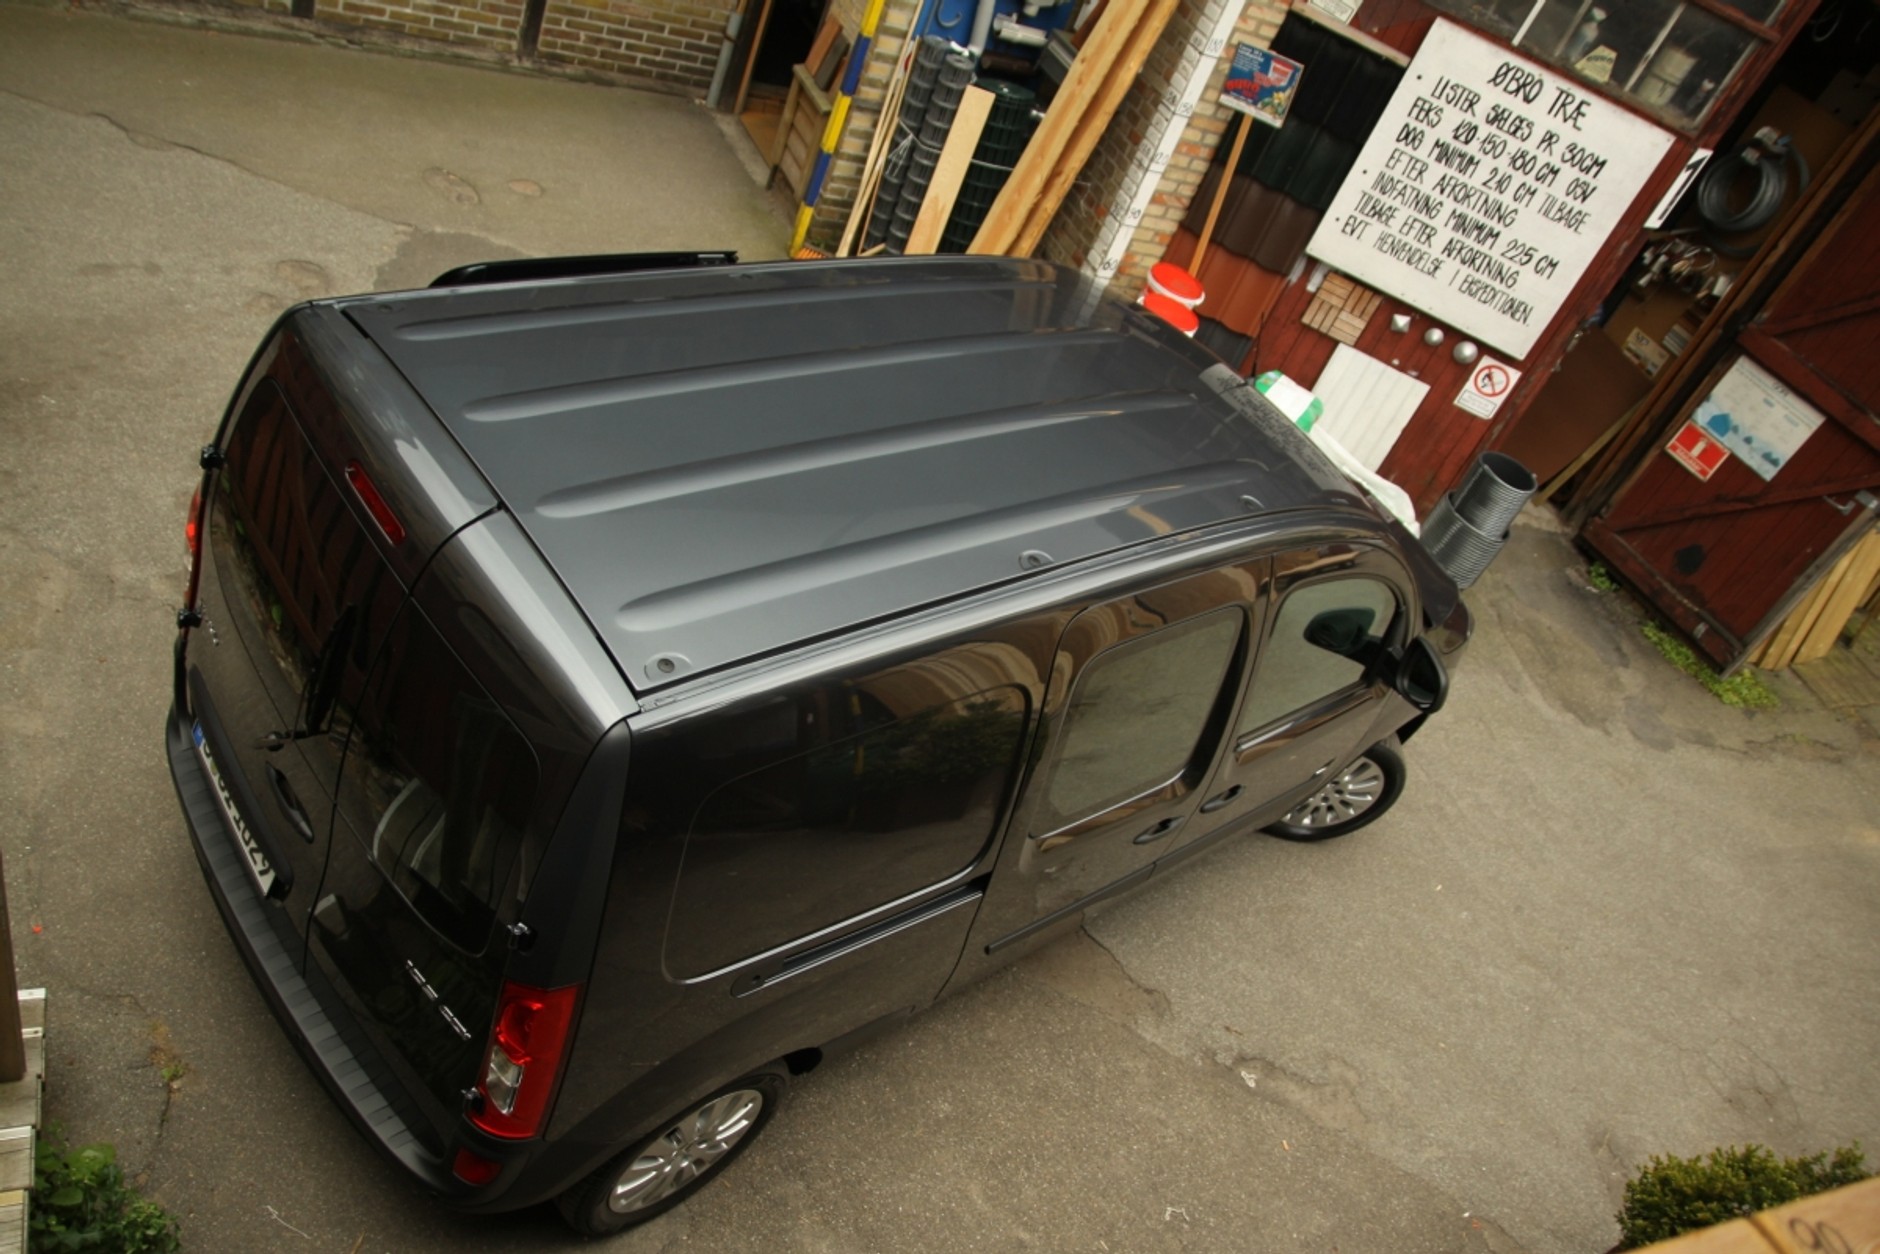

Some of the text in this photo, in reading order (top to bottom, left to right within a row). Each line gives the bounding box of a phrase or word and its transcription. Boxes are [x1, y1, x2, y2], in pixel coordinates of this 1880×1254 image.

[1430, 75, 1481, 118] LISTER
[1485, 103, 1535, 143] SÆLGES
[1536, 129, 1560, 157] PR
[1486, 61, 1591, 132] ØBRO TRÆ
[1385, 147, 1519, 228] EFTER AFKORTNING
[1395, 122, 1591, 235] DOG MINIMUM 210 CM TILBAGE
[1534, 161, 1561, 188] CM
[1565, 177, 1598, 204] OSV
[1354, 190, 1400, 228] TILBAGE
[1398, 215, 1438, 248] EFTER
[1371, 170, 1560, 280] INDFATNING MINIMUM 225 CM
[1373, 230, 1445, 279] HENVENDELSE
[1449, 269, 1460, 286] I
